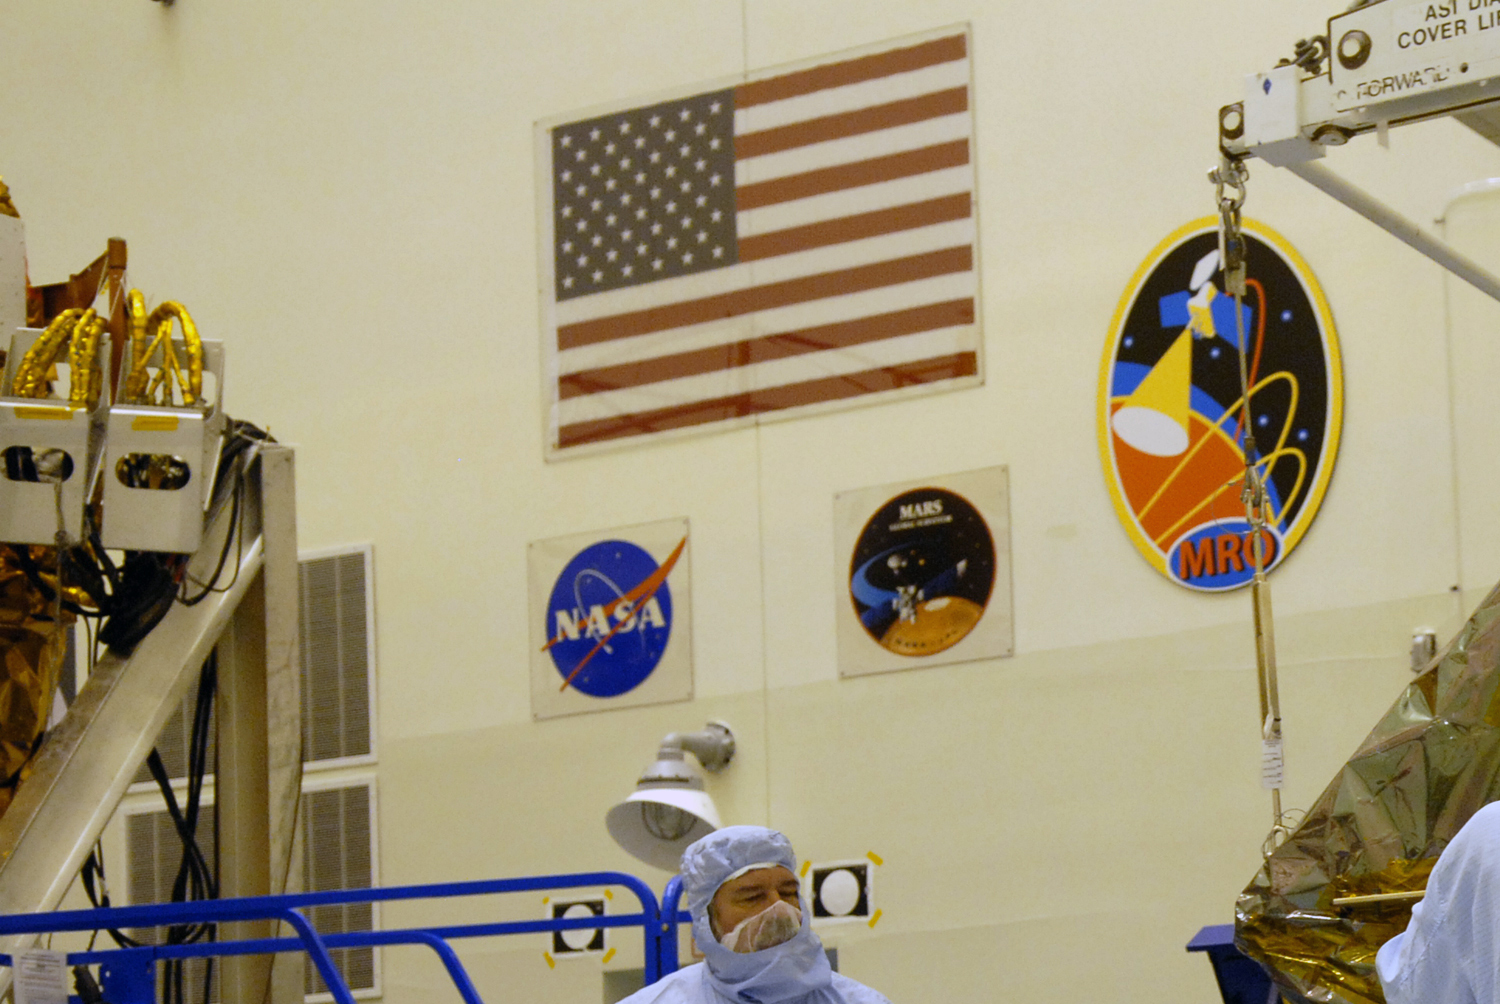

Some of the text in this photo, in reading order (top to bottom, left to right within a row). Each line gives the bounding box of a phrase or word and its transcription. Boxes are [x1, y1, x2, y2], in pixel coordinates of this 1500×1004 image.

[1398, 19, 1467, 49] COVER
[900, 499, 943, 520] MARS
[1180, 529, 1276, 579] MRO
[555, 596, 666, 643] NASA
